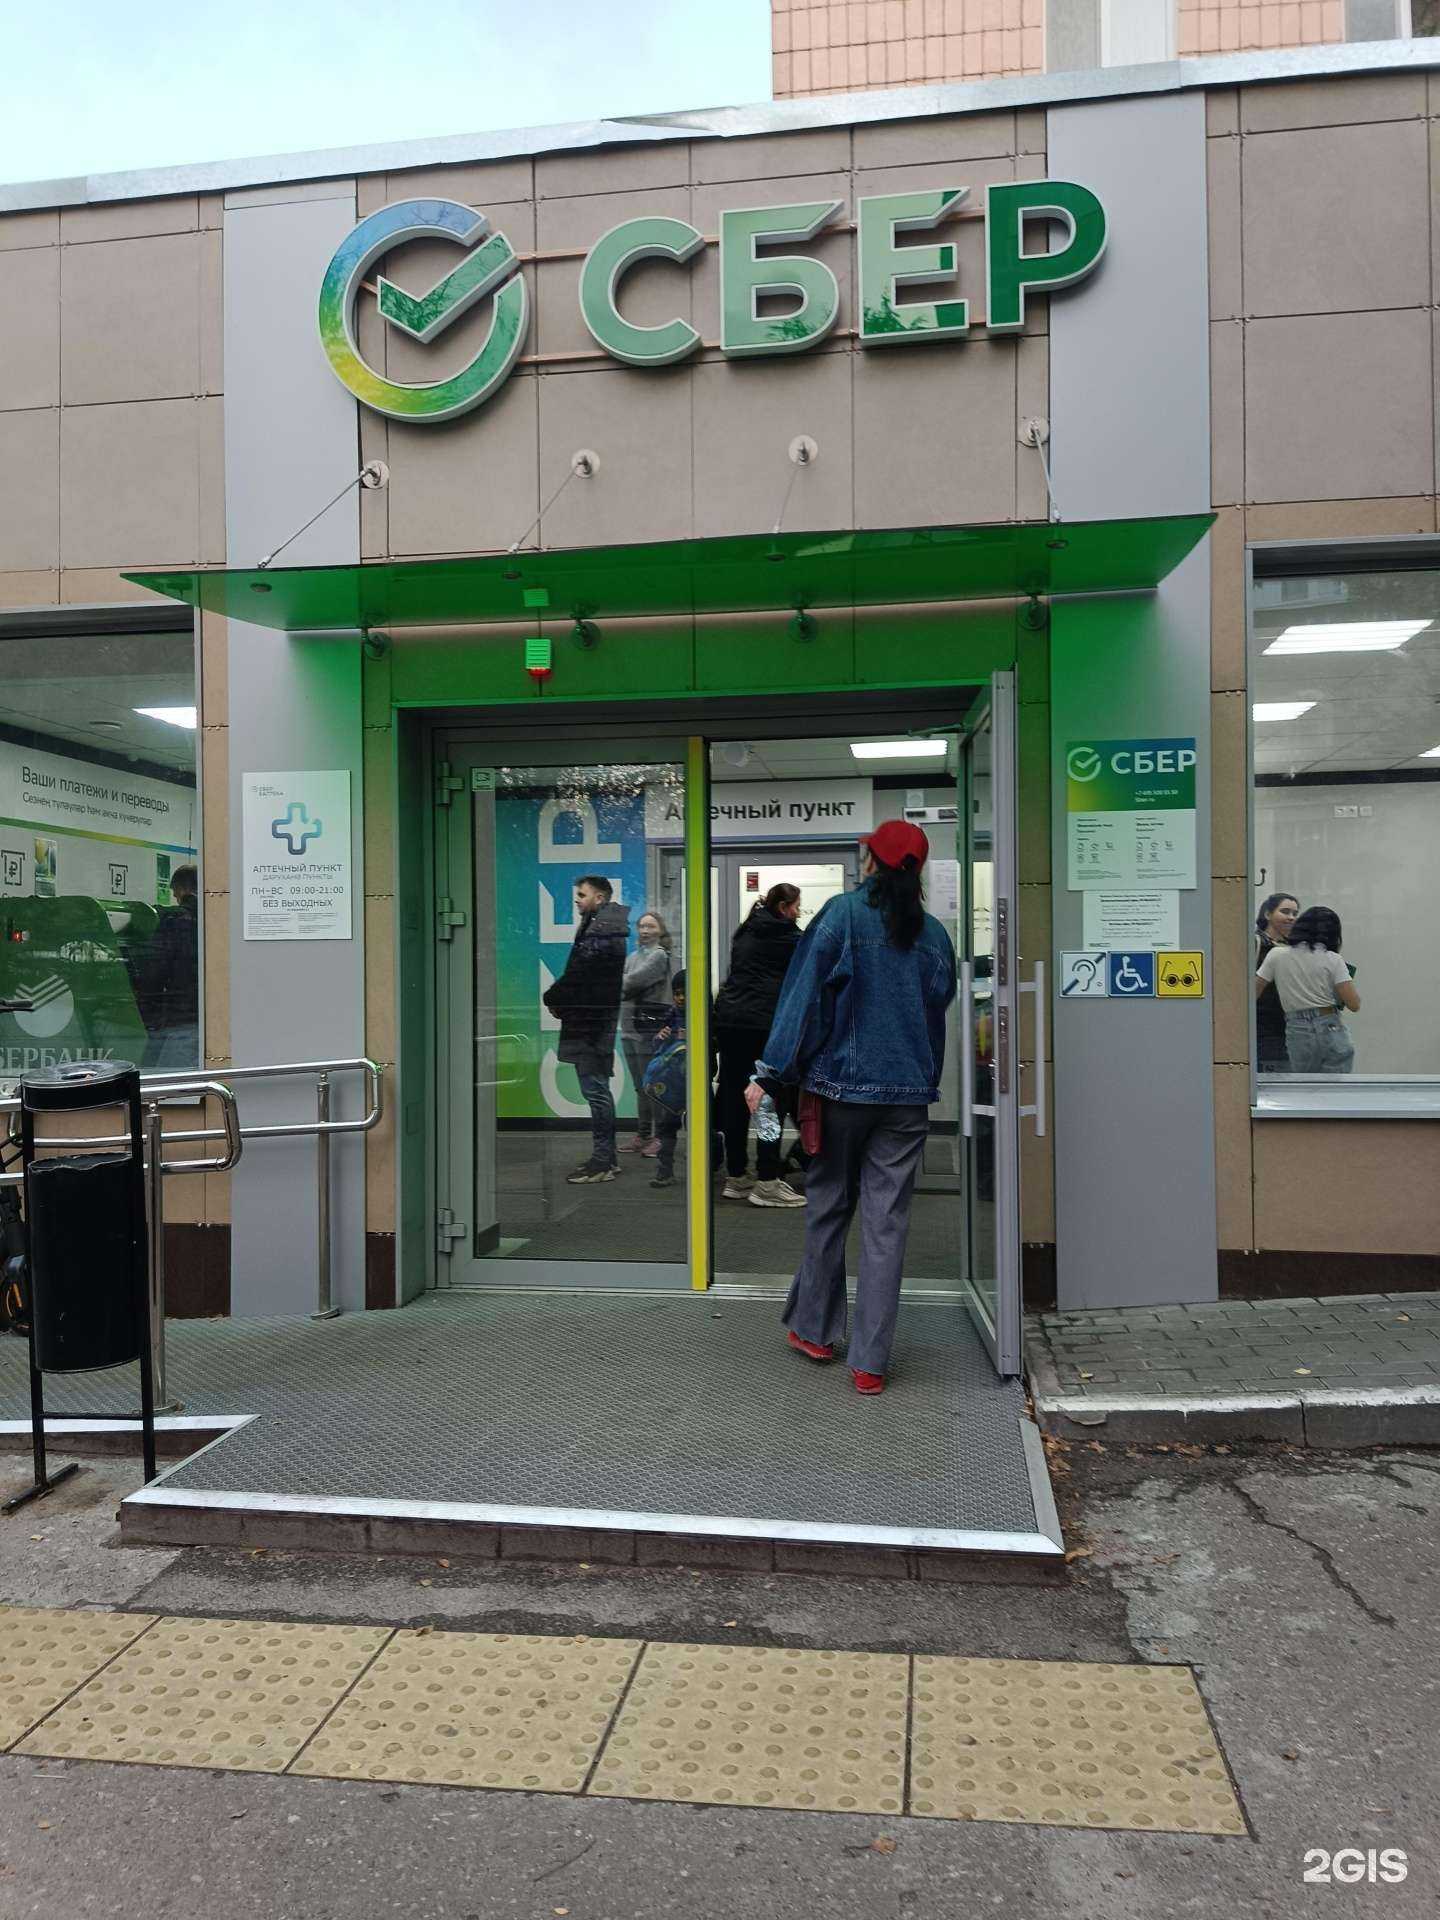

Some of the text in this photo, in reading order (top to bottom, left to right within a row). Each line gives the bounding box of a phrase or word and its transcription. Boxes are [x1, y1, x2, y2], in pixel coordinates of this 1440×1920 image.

[579, 179, 1108, 367] СБЕР
[1110, 749, 1197, 774] СБЕР
[22, 766, 170, 814] Ваши платежи и переводы
[664, 799, 855, 822] Аечный пункт
[253, 864, 343, 873] АПТЕЧНЫЙ ПУНКТ
[290, 886, 344, 895] 09:00-21:00
[262, 899, 333, 908] БЕЗ ВЫХОДНЫХ
